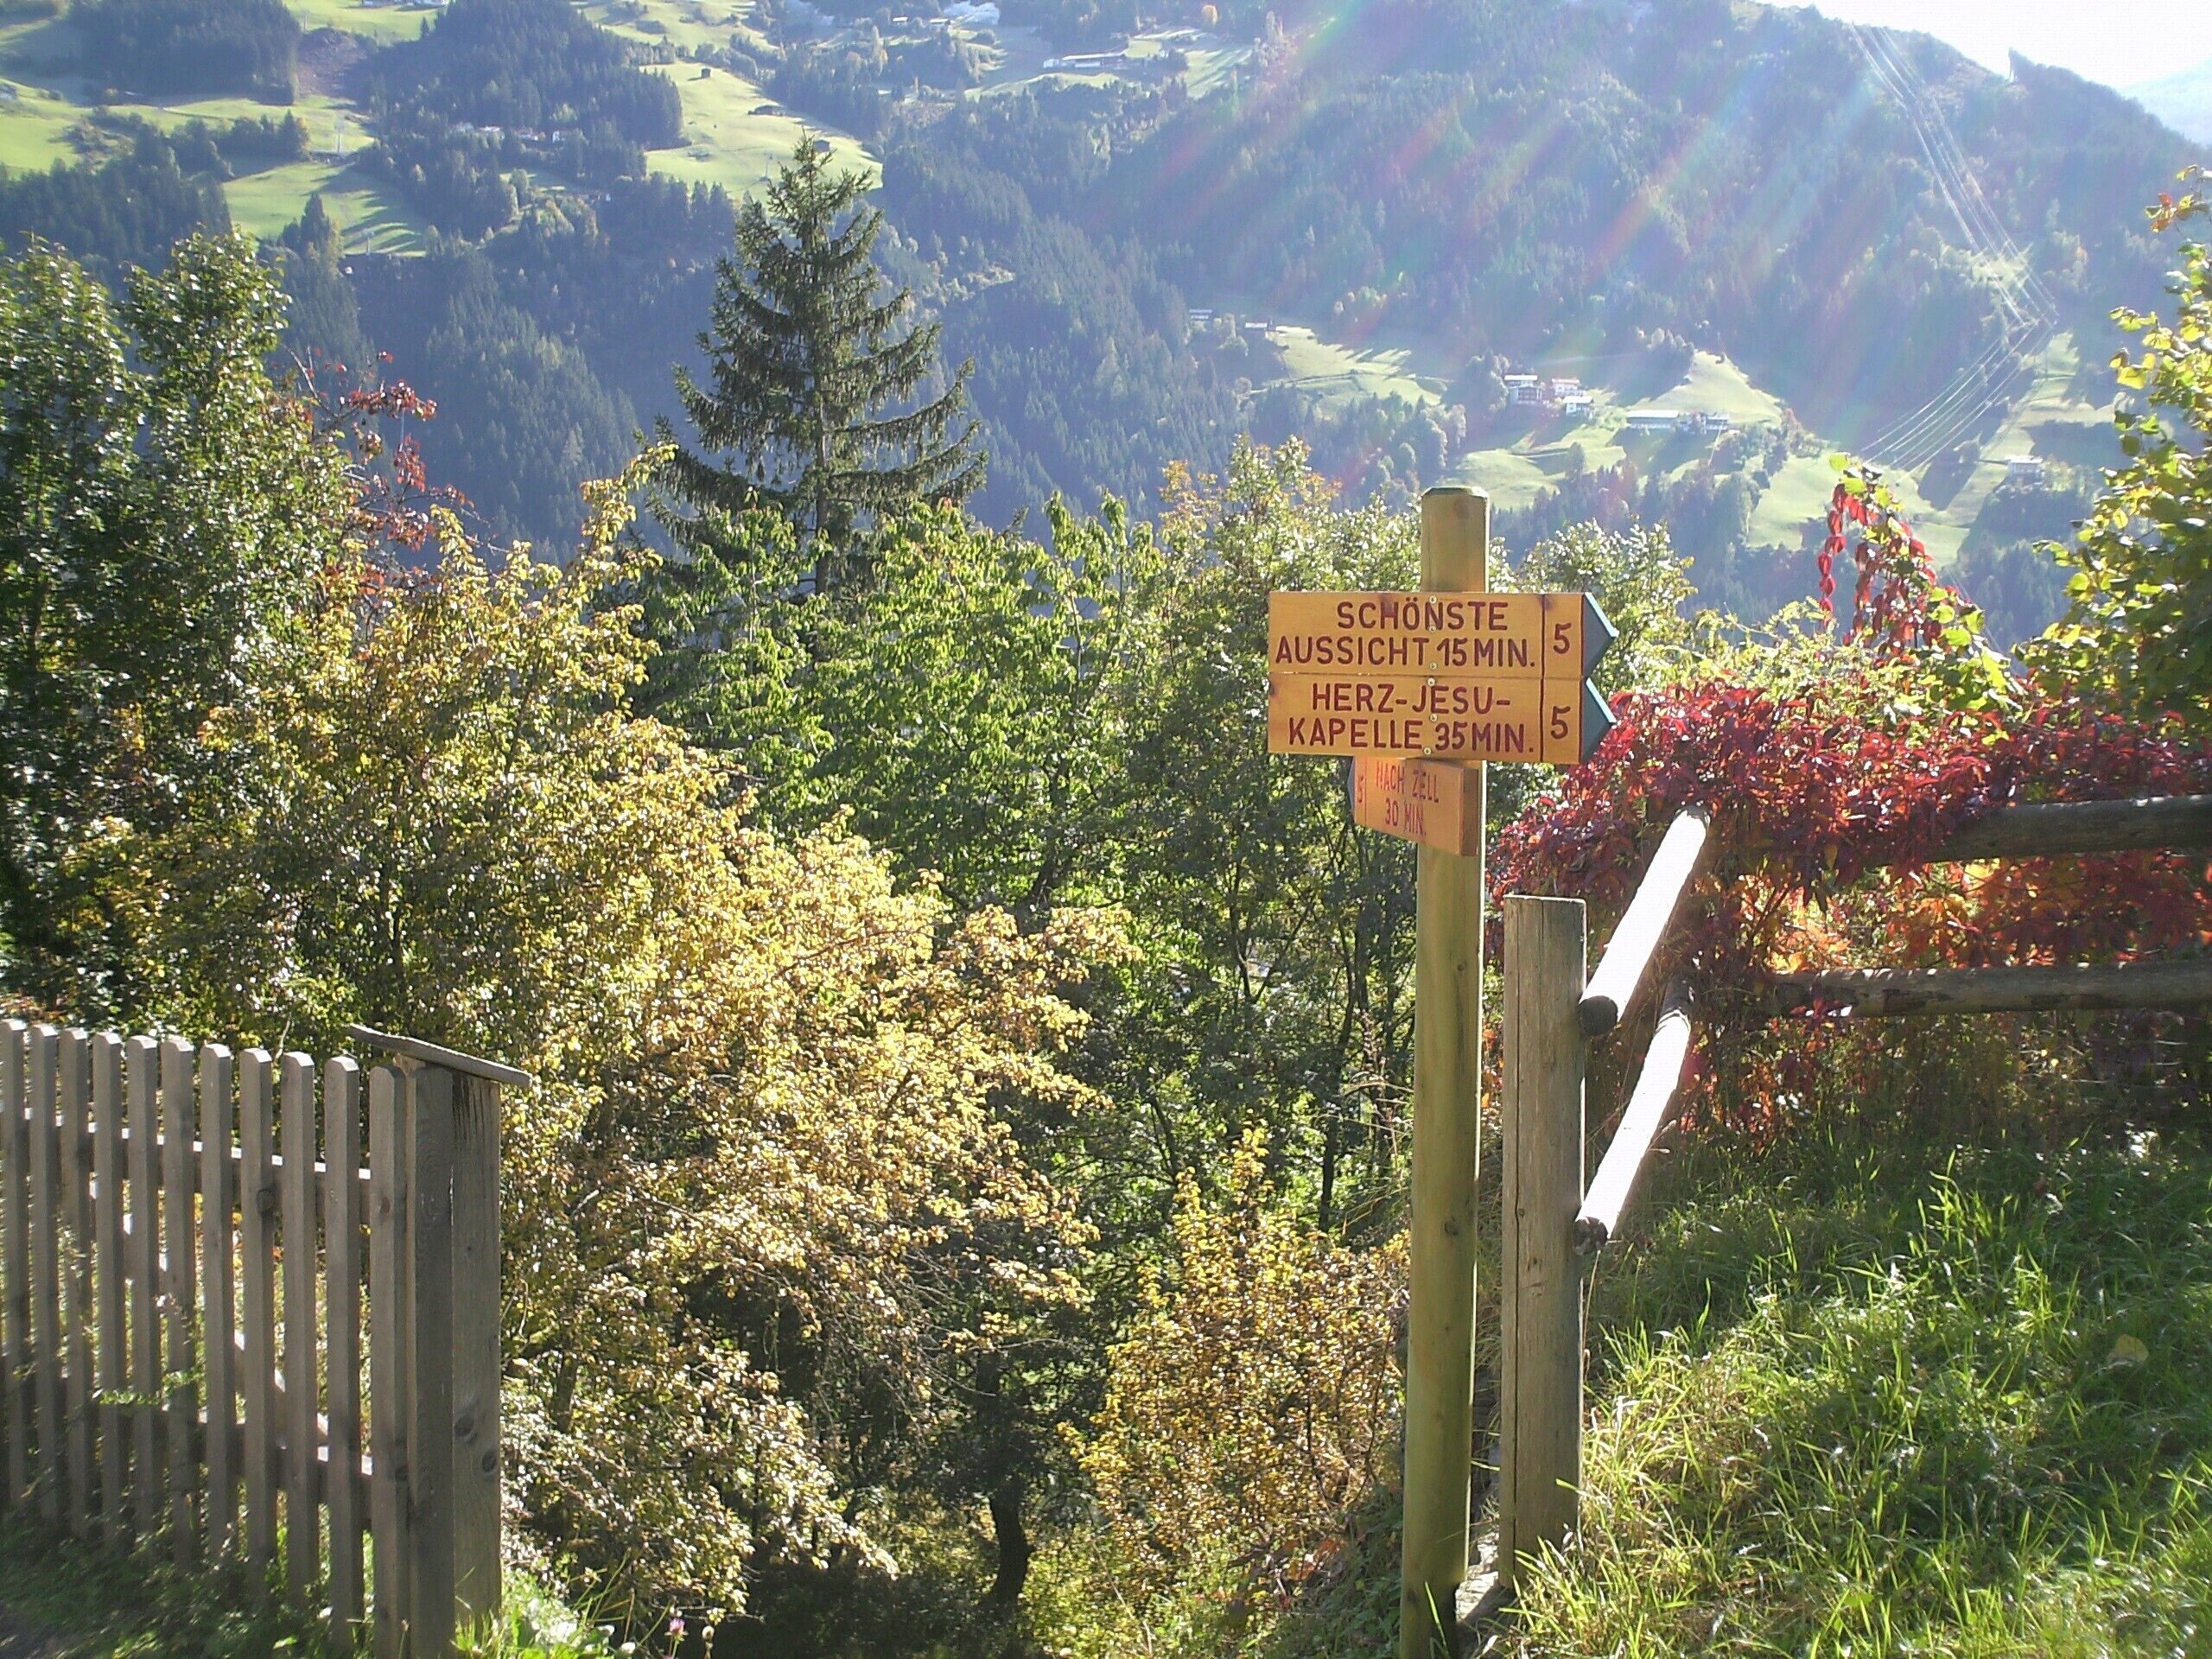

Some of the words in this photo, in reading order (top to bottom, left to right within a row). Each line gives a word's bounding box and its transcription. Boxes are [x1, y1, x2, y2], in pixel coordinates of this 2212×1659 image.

[1337, 596, 1509, 631] SCHÖNSTE
[1275, 635, 1430, 665] AUSSICHT
[1436, 637, 1467, 667] 15
[1473, 637, 1536, 668] MIN.
[1553, 622, 1572, 654] 5
[1312, 683, 1511, 715] HERZ-JESU-
[1288, 716, 1424, 750] KAPELLE
[1434, 721, 1468, 752] 35
[1472, 721, 1535, 753] MIN.
[1550, 706, 1571, 740] 5
[1376, 760, 1405, 794] NACH
[1412, 768, 1440, 804] ZELL
[1385, 798, 1399, 827] 30
[1403, 800, 1427, 836] MIN.
